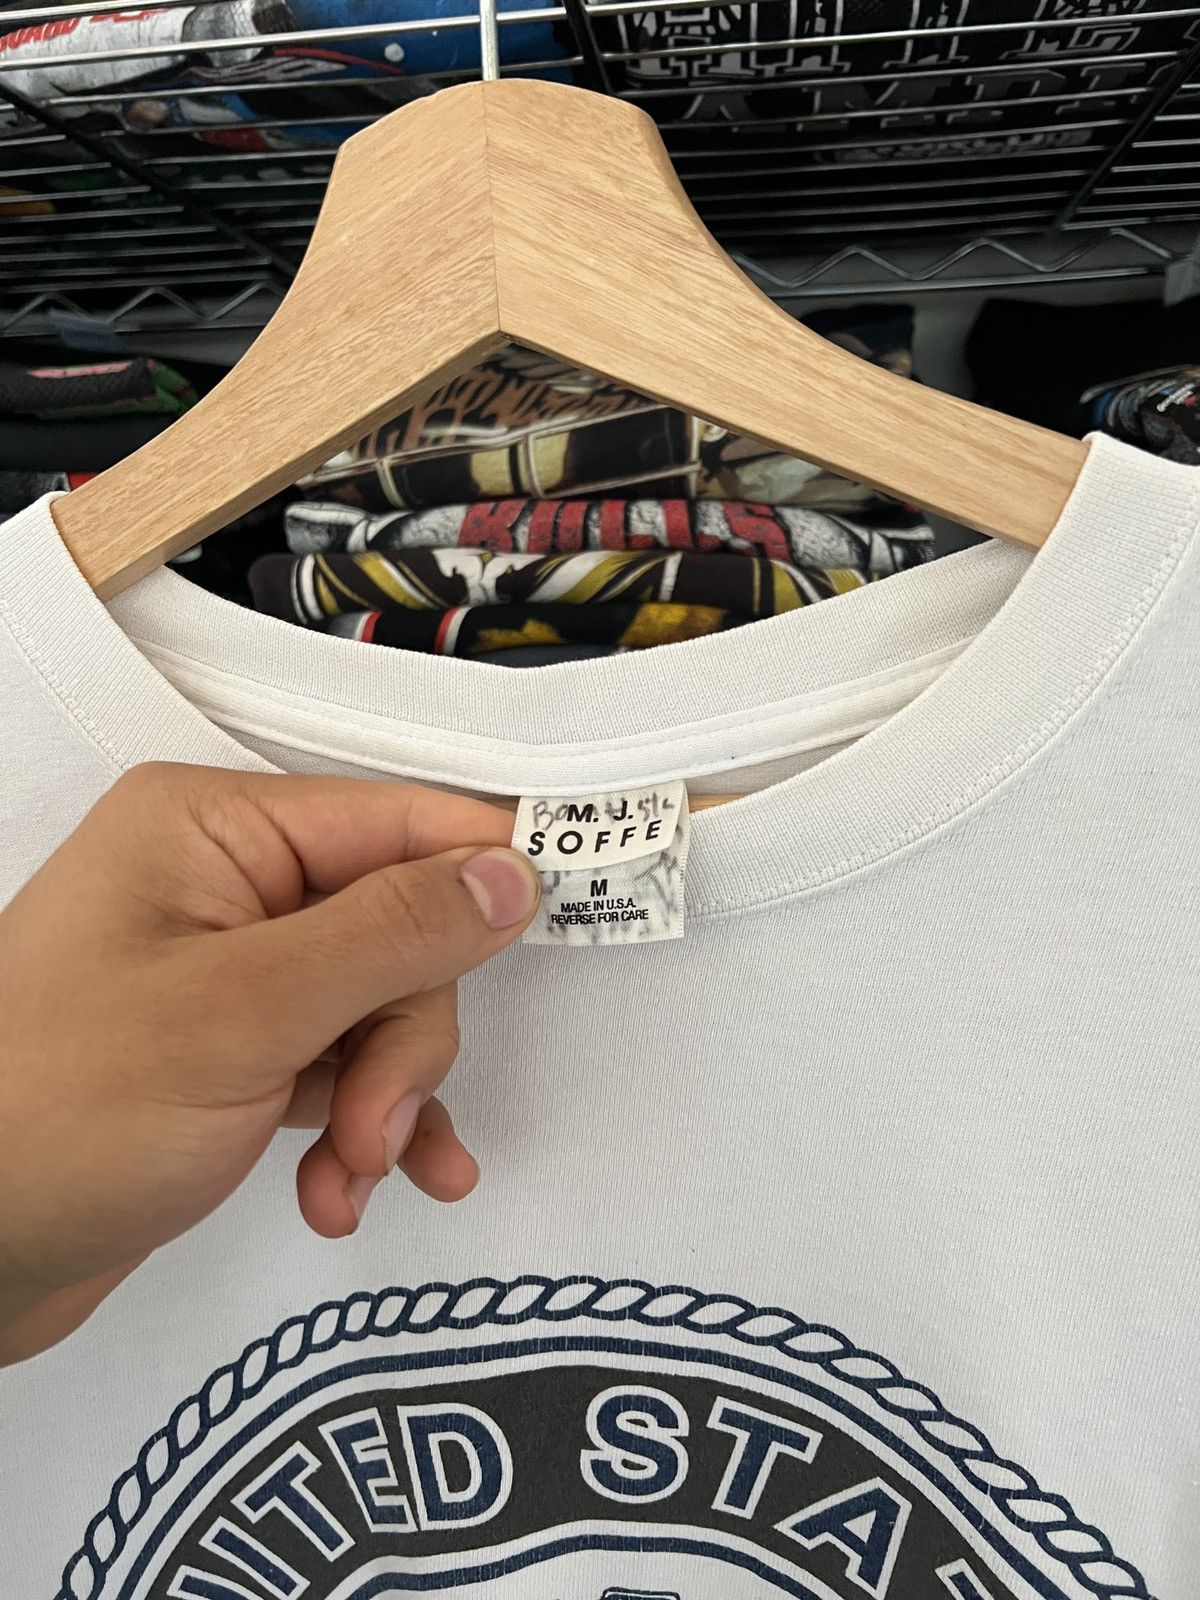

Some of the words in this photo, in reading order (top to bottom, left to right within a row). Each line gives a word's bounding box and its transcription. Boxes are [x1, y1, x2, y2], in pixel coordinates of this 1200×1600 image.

[567, 803, 599, 823] M.
[613, 800, 634, 821] J.
[527, 820, 662, 856] SOFFE
[590, 879, 608, 897] M
[561, 901, 591, 913] MADE
[593, 900, 605, 911] IN
[606, 898, 637, 910] U.S.A.
[551, 913, 596, 925] REVERSE
[597, 912, 619, 923] FOR
[621, 909, 649, 921] CARE
[166, 1402, 514, 1600] ITED
[580, 1384, 1000, 1600] STA
